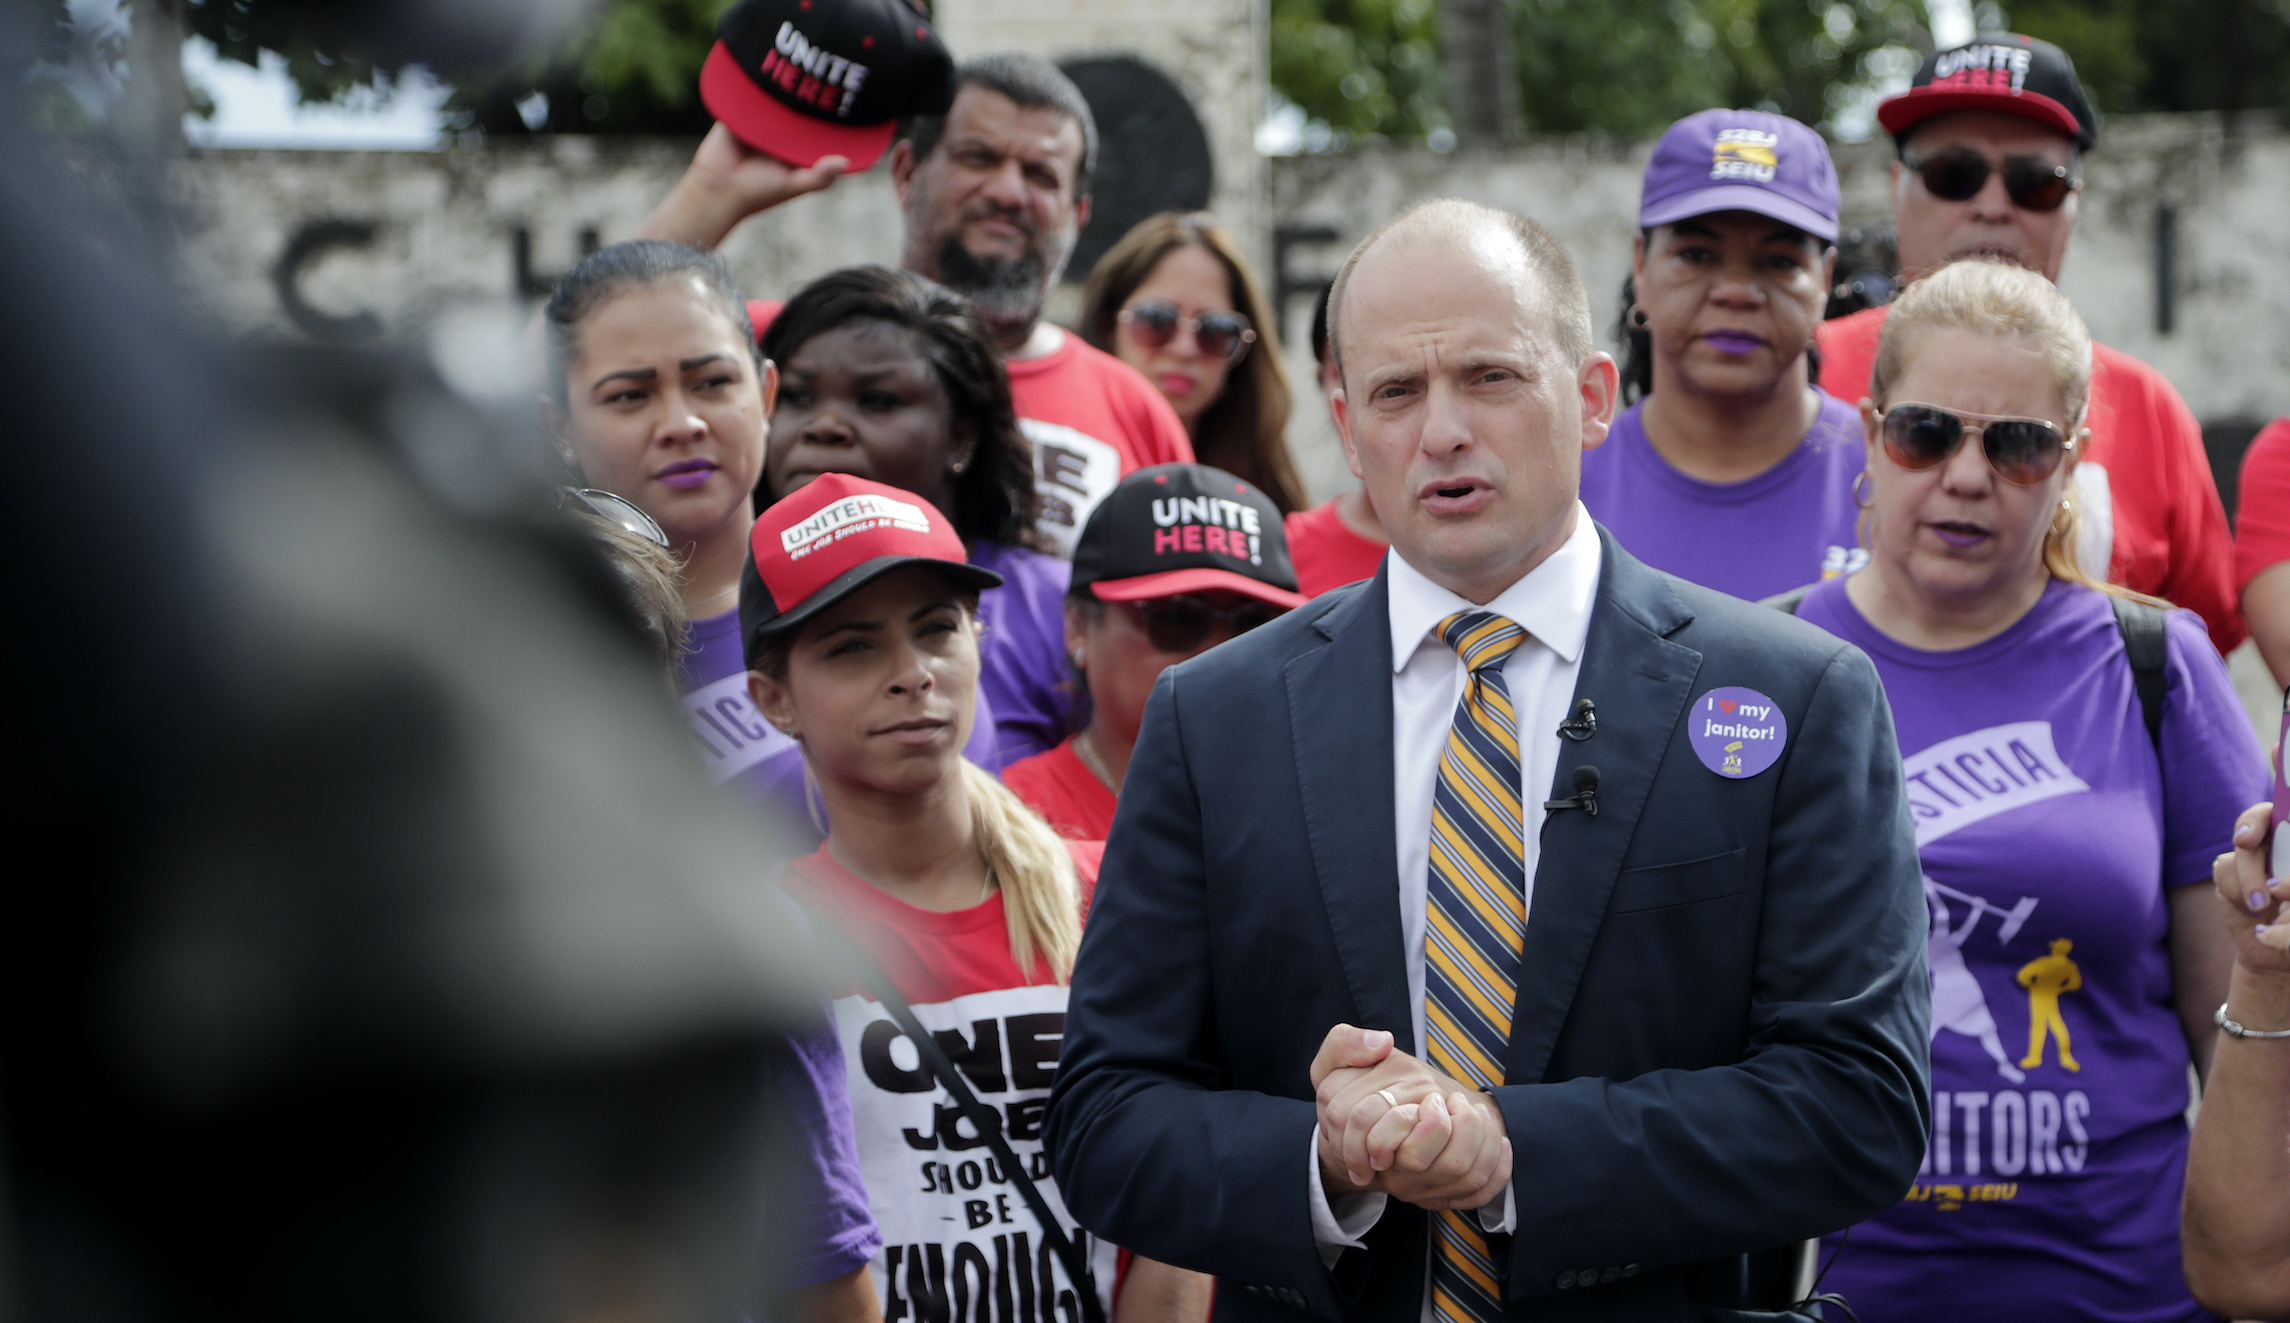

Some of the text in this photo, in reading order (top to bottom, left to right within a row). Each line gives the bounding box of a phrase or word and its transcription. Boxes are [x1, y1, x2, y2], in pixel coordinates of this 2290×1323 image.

[775, 20, 870, 92] UNITE
[1934, 45, 2033, 78] UNITE
[761, 47, 856, 117] HERE!
[1709, 161, 1776, 183] SEIU
[1152, 496, 1262, 535] UNITE
[790, 544, 812, 561] ONE
[813, 534, 833, 551] JOB
[834, 519, 876, 540] SHOULD
[1154, 525, 1262, 566] HERE!
[1704, 719, 1775, 740] janitor!
[1707, 697, 1771, 721] I my
[861, 1013, 1066, 1093] ONE
[1920, 1089, 2091, 1177] ITORS
[921, 1151, 1051, 1194] SHOUD
[965, 1195, 1013, 1230] BE
